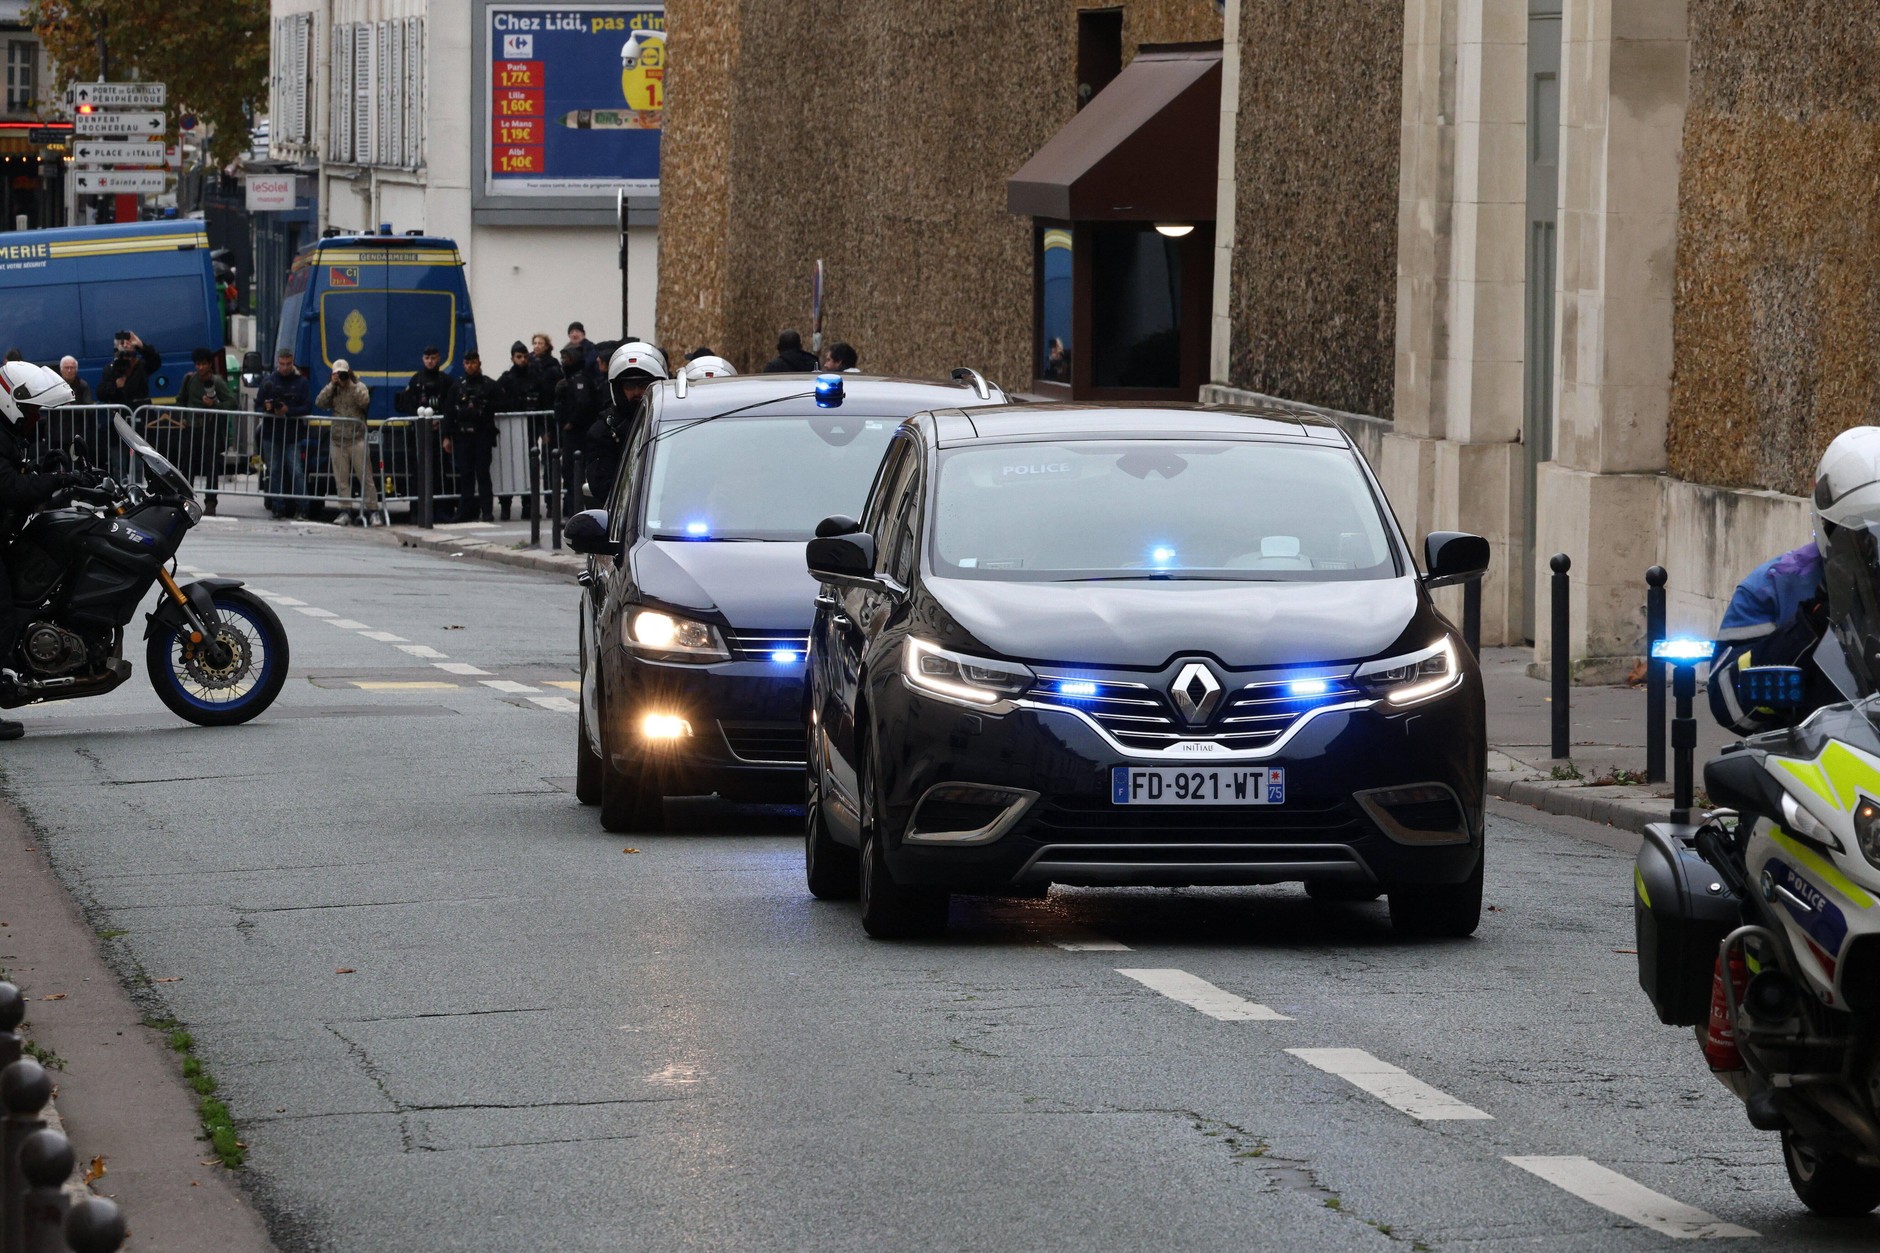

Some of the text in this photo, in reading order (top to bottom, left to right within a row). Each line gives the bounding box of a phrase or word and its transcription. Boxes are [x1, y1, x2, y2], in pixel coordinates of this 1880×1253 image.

[494, 13, 540, 30] Chez
[591, 17, 624, 34] pas
[507, 63, 527, 71] Paris
[501, 71, 531, 86] 1.77€
[93, 95, 161, 103] PÉRIPHÉRIQUE
[509, 91, 525, 99] Lille
[501, 99, 533, 115] 1.60€
[501, 120, 532, 128] Le Mans
[501, 128, 531, 143] 1.19€
[95, 149, 122, 157] PLACE
[509, 148, 525, 156] Albi
[501, 156, 533, 171] 1.40€
[110, 178, 162, 186] Sainte Anne
[360, 253, 417, 261] GENDARMERIE
[1003, 463, 1071, 476] POLICE
[1118, 772, 1282, 800] F FD-921-WT 75
[1788, 870, 1826, 912] POLICE
